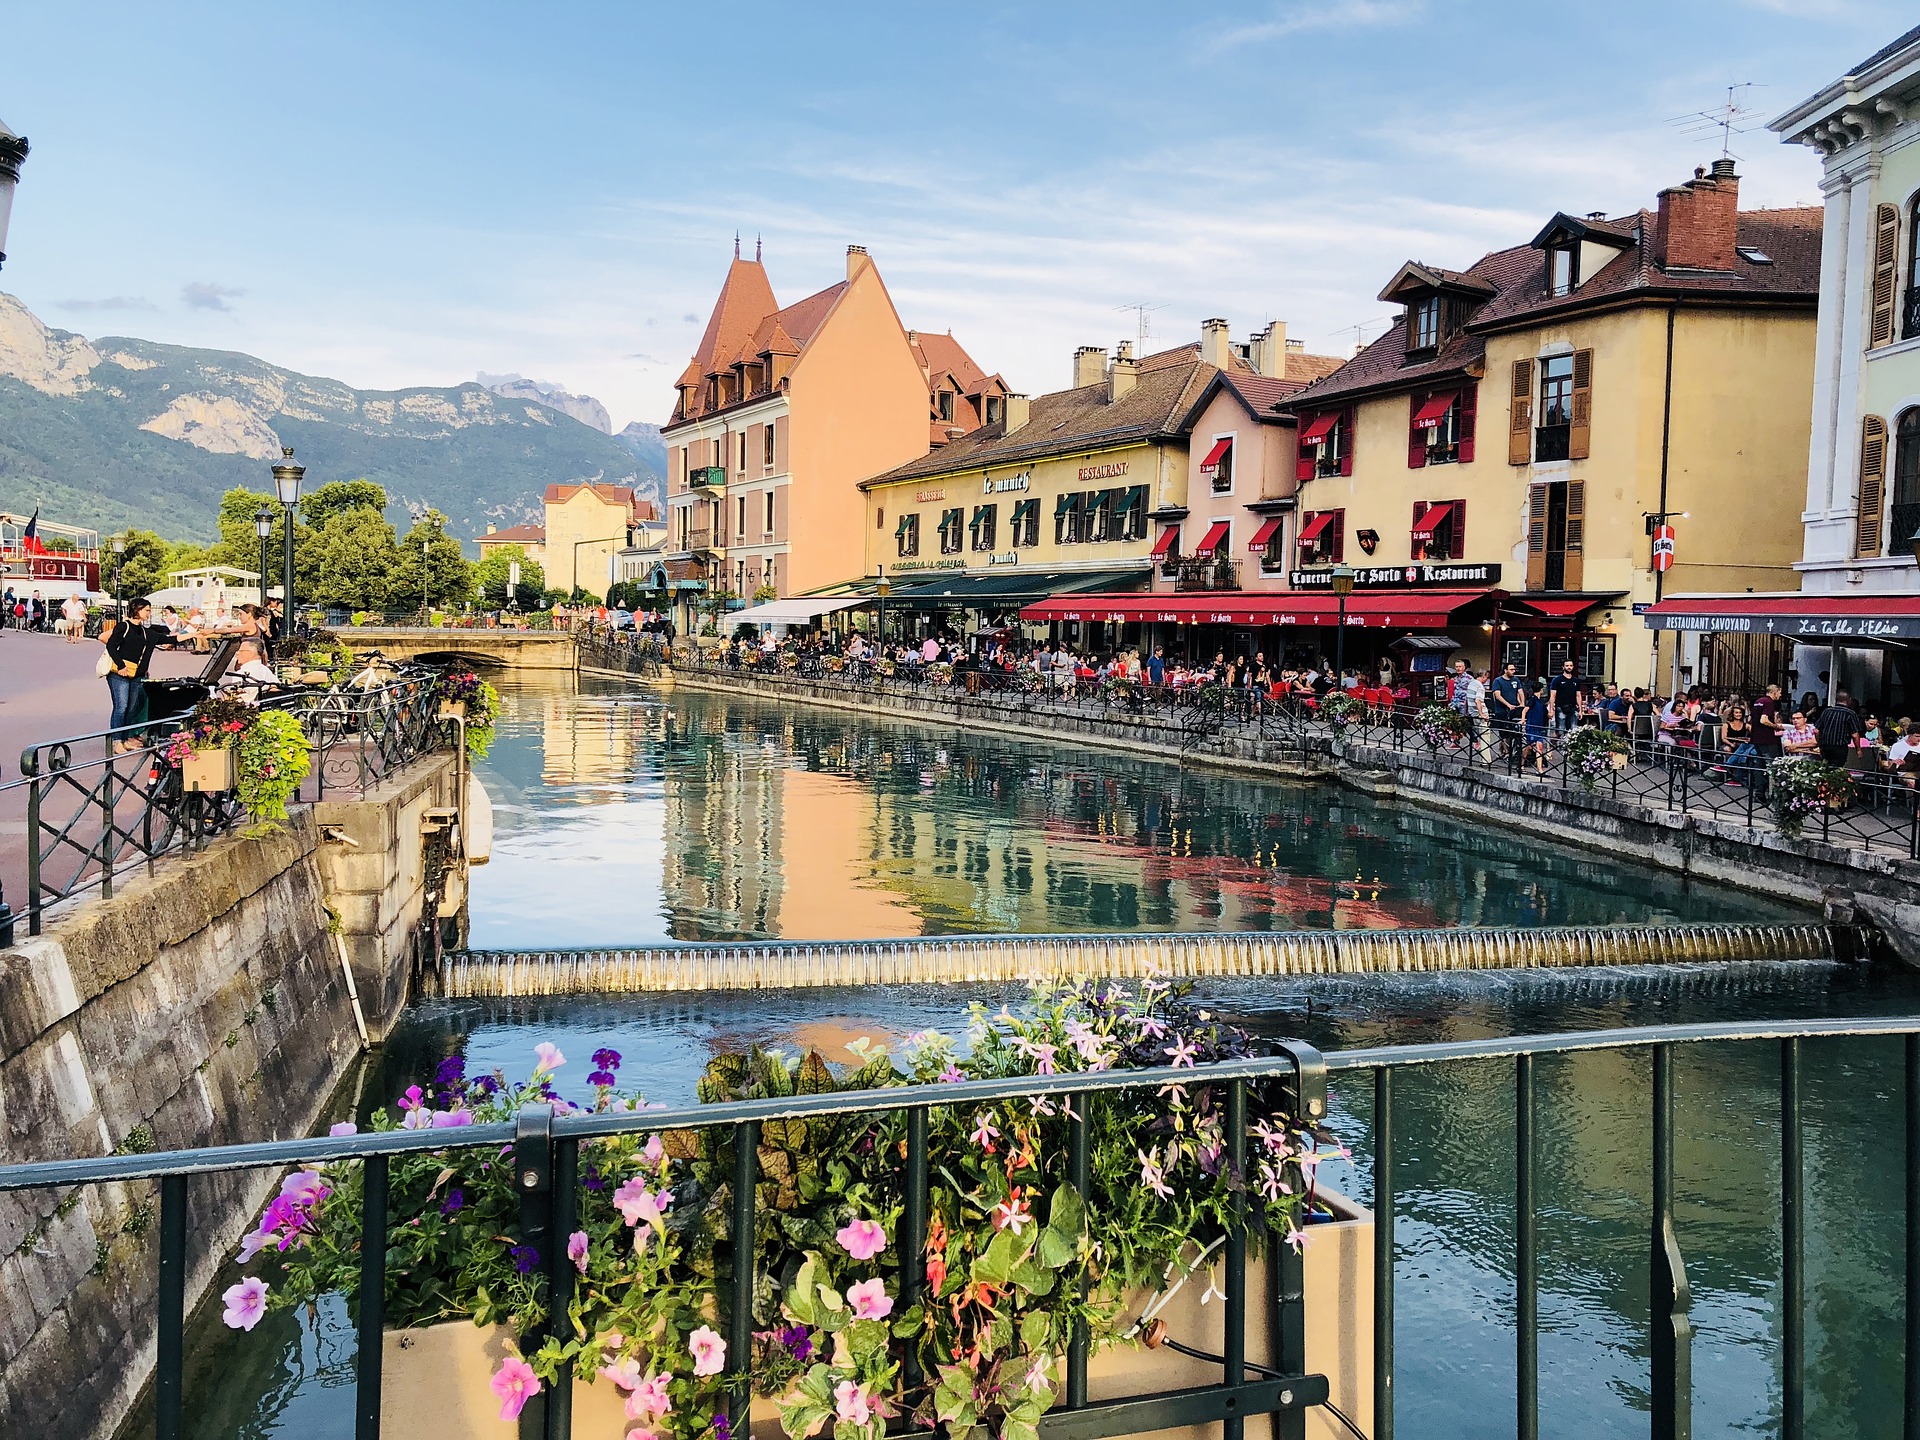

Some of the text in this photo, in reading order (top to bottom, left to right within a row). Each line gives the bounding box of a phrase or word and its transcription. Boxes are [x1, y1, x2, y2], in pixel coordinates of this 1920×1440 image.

[1078, 462, 1128, 481] RESTAURANT
[983, 471, 1030, 494] le munich
[917, 489, 946, 503] BRASSERIE
[1354, 569, 1366, 583] Le
[1369, 568, 1402, 584] Sarto
[1422, 566, 1488, 581] Restaurant
[1279, 613, 1296, 624] Sarto
[1346, 615, 1365, 625] Sarto
[1666, 617, 1750, 631] RESTAURANT SAVOYARD
[1799, 619, 1899, 635] La Table d'Elise
